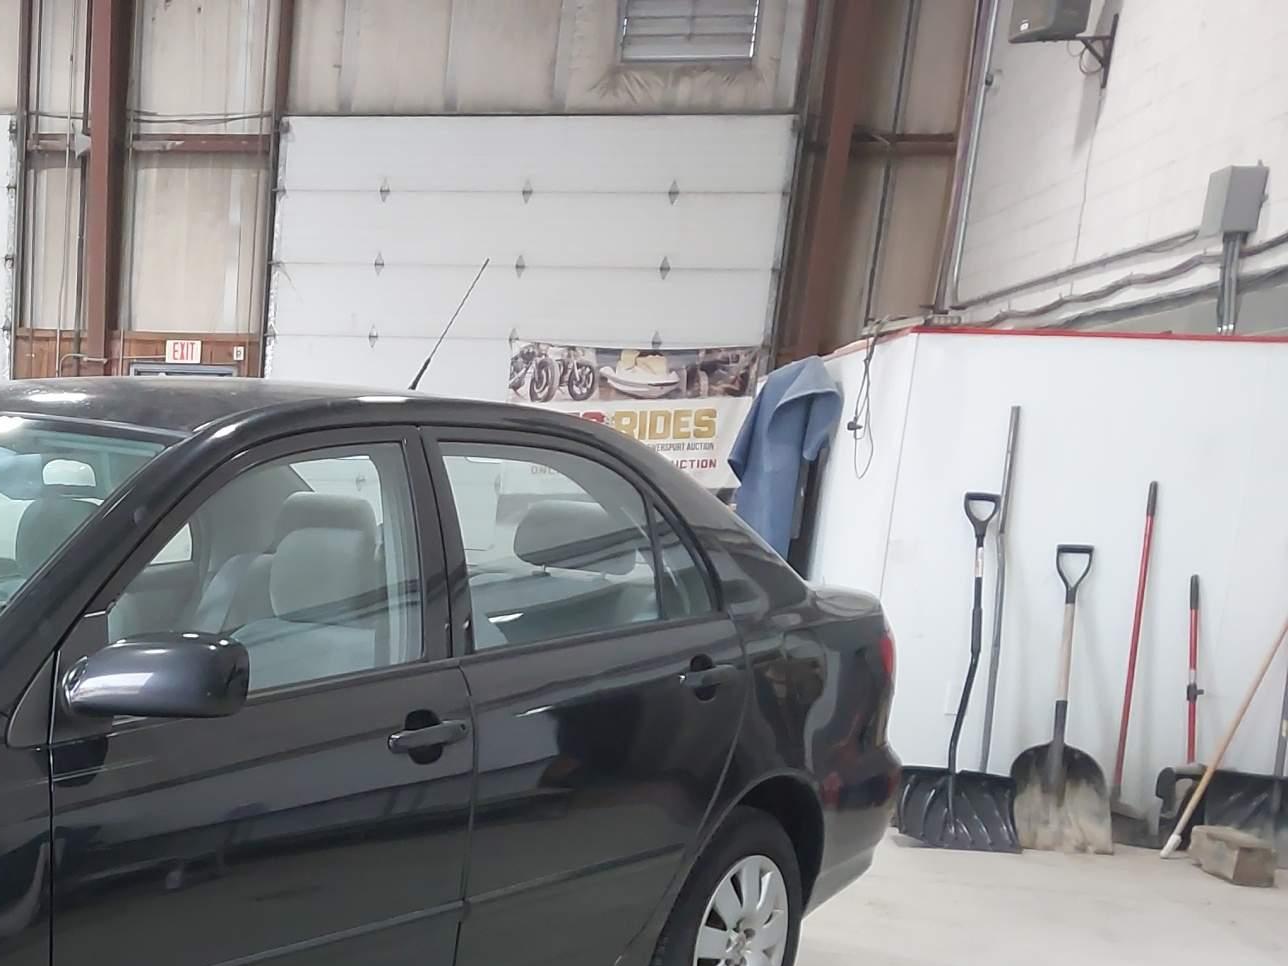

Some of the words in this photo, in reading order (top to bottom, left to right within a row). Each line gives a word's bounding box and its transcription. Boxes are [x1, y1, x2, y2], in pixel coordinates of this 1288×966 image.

[172, 342, 196, 361] EXIT
[614, 408, 718, 441] RIDES
[671, 458, 717, 469] UCTION
